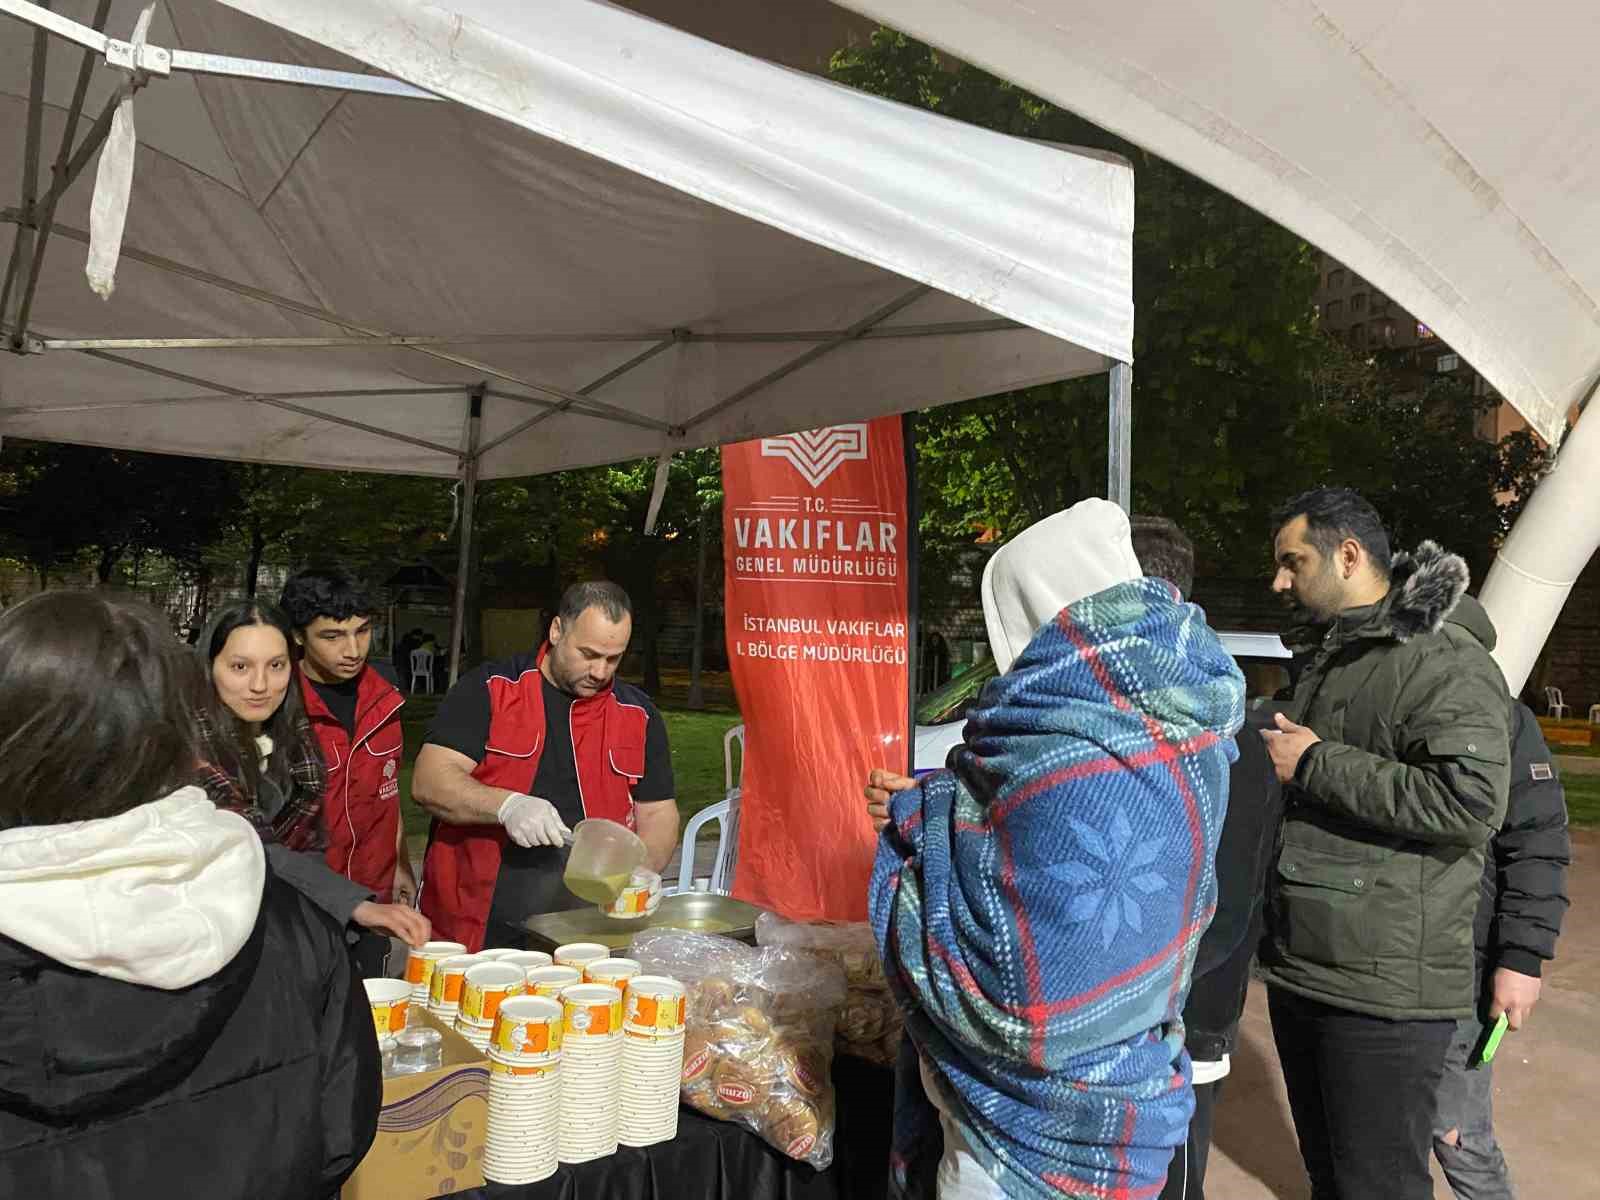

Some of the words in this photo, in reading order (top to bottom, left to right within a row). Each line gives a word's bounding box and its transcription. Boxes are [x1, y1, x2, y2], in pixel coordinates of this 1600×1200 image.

[803, 497, 828, 513] T.C.
[734, 518, 896, 553] VAKIFLAR
[736, 556, 784, 573] GENEL
[793, 555, 896, 577] MÜDÜRLÜĞÜ
[744, 613, 822, 634] İSTANBUL
[827, 620, 905, 638] VAKIFLAR
[748, 641, 798, 660] BÖLGE
[803, 642, 906, 665] MÜDÜRLÜĞÜ
